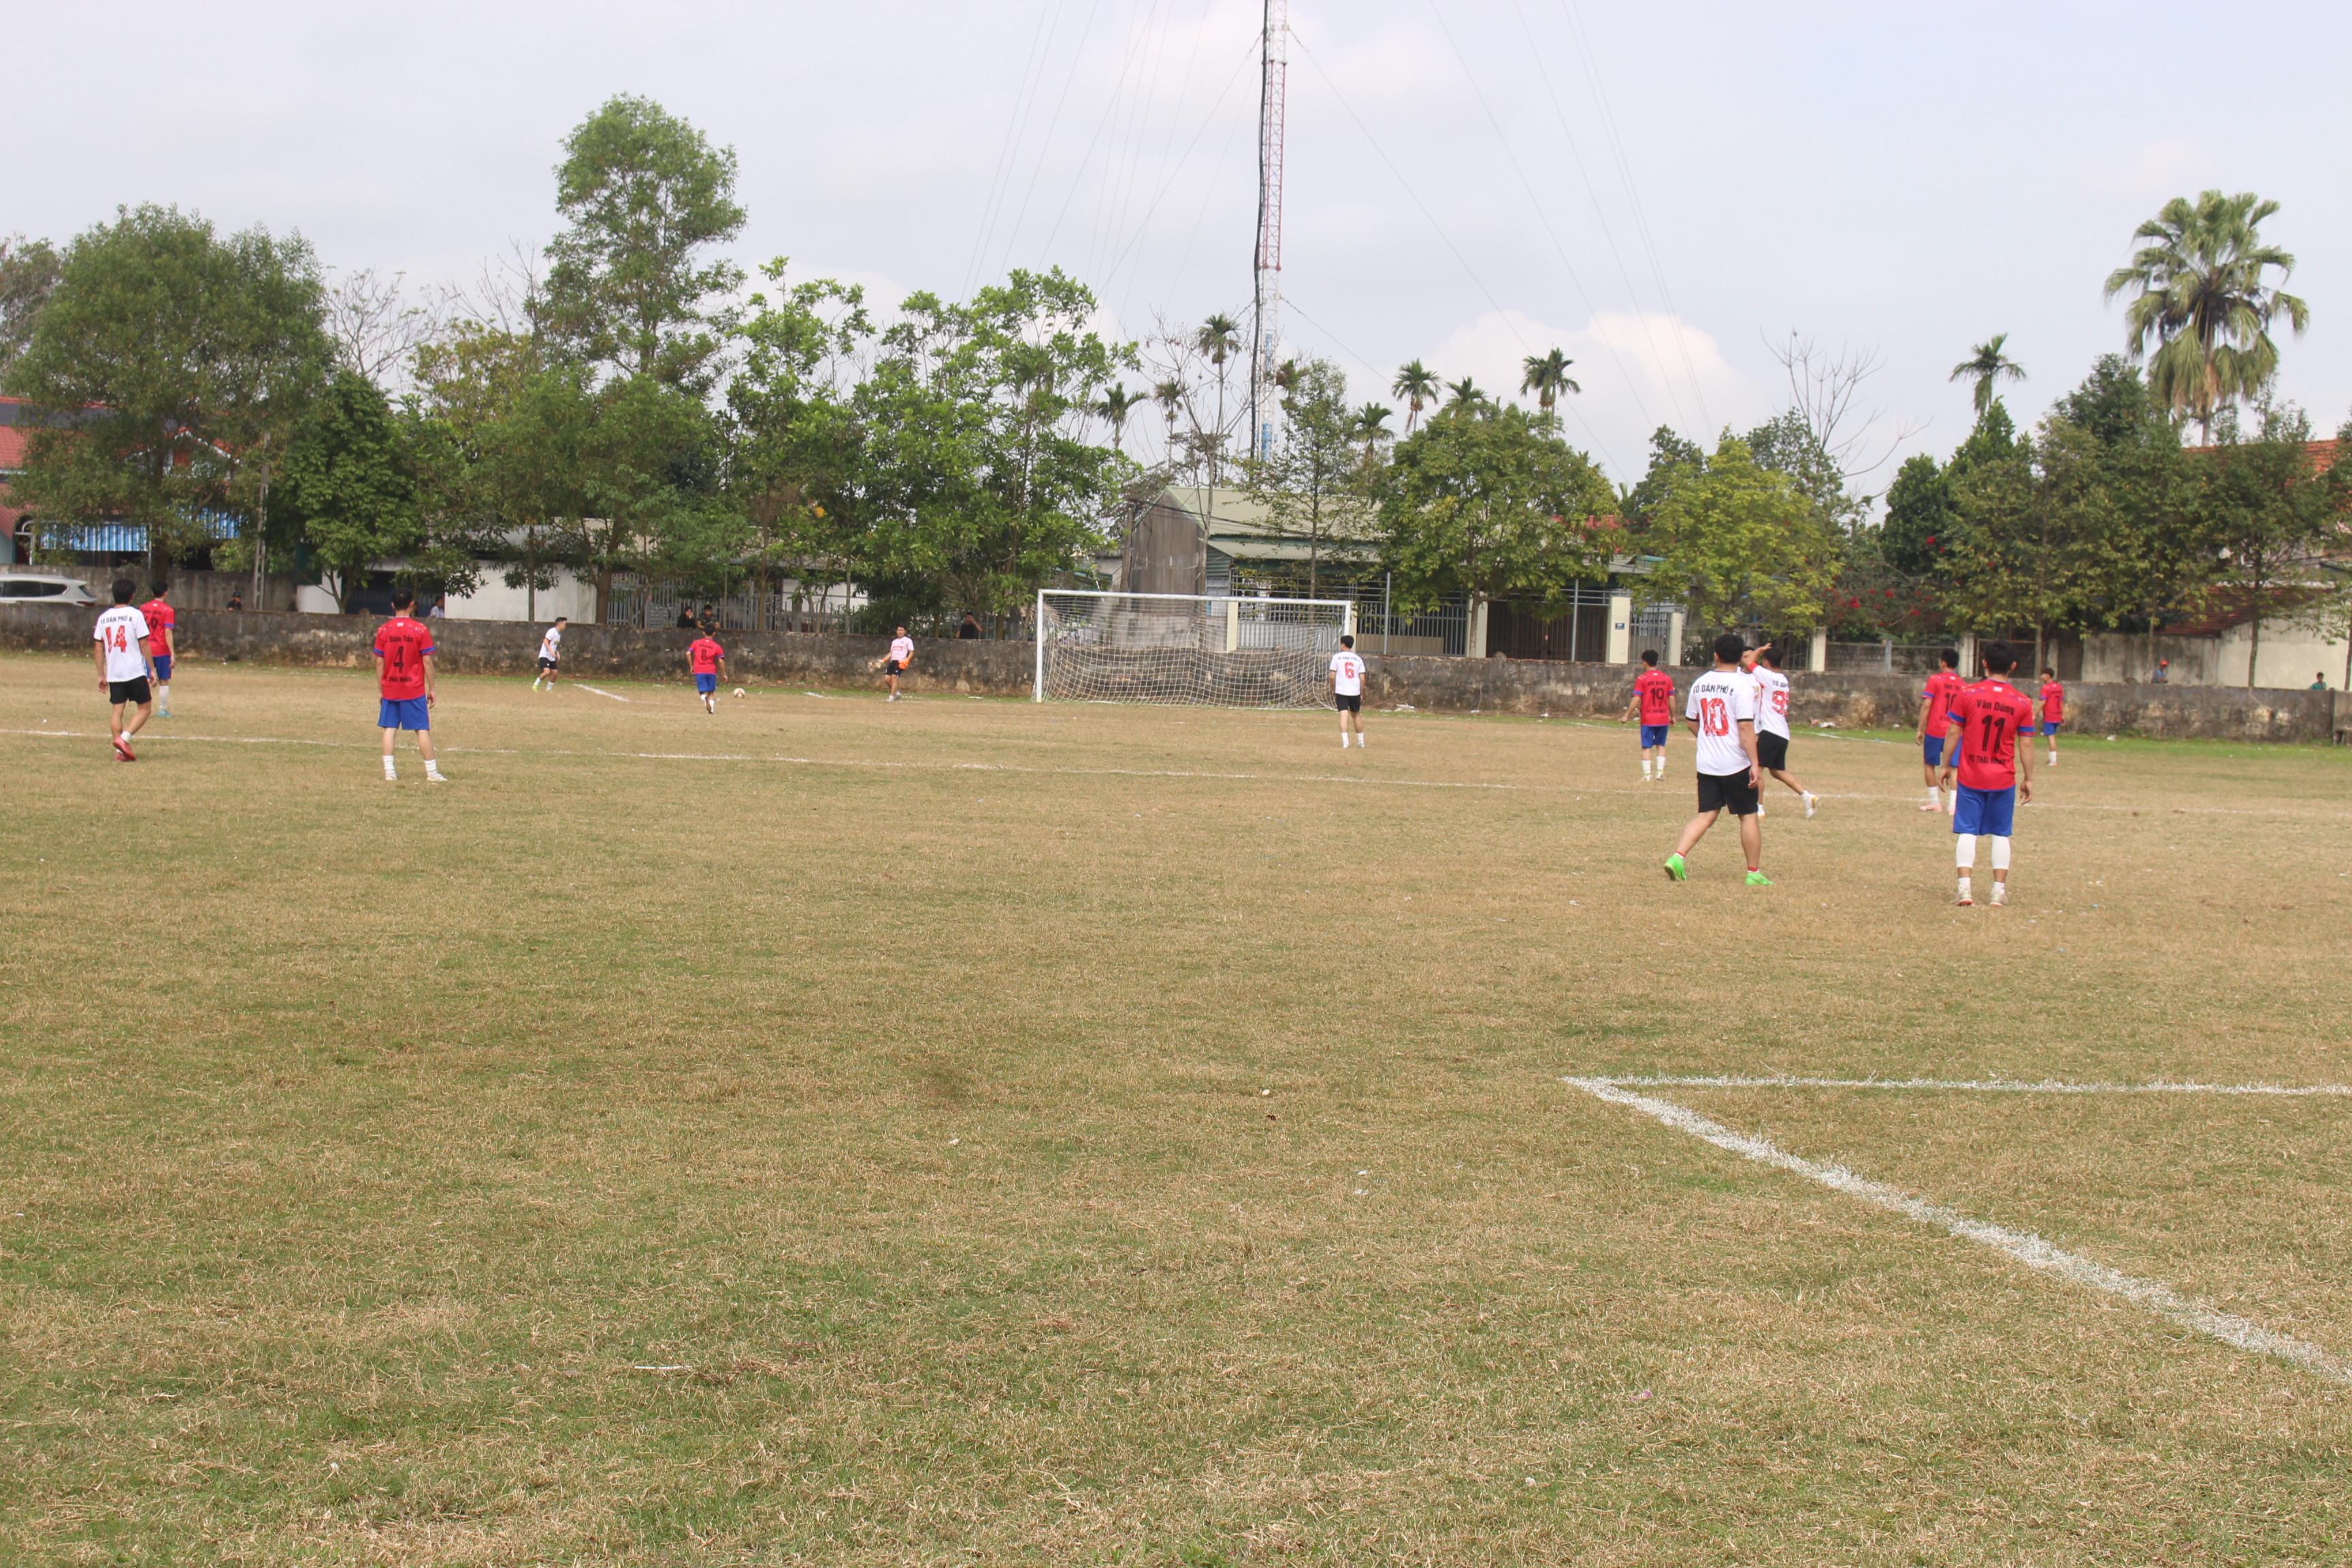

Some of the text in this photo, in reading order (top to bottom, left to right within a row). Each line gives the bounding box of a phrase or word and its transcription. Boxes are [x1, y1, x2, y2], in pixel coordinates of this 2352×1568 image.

[105, 625, 127, 653] 14
[393, 646, 404, 673] 4
[701, 649, 708, 661] 8
[1345, 662, 1354, 679] 6
[1650, 688, 1665, 707] 19
[1700, 698, 1729, 736] 10
[1981, 715, 2006, 753] 11
